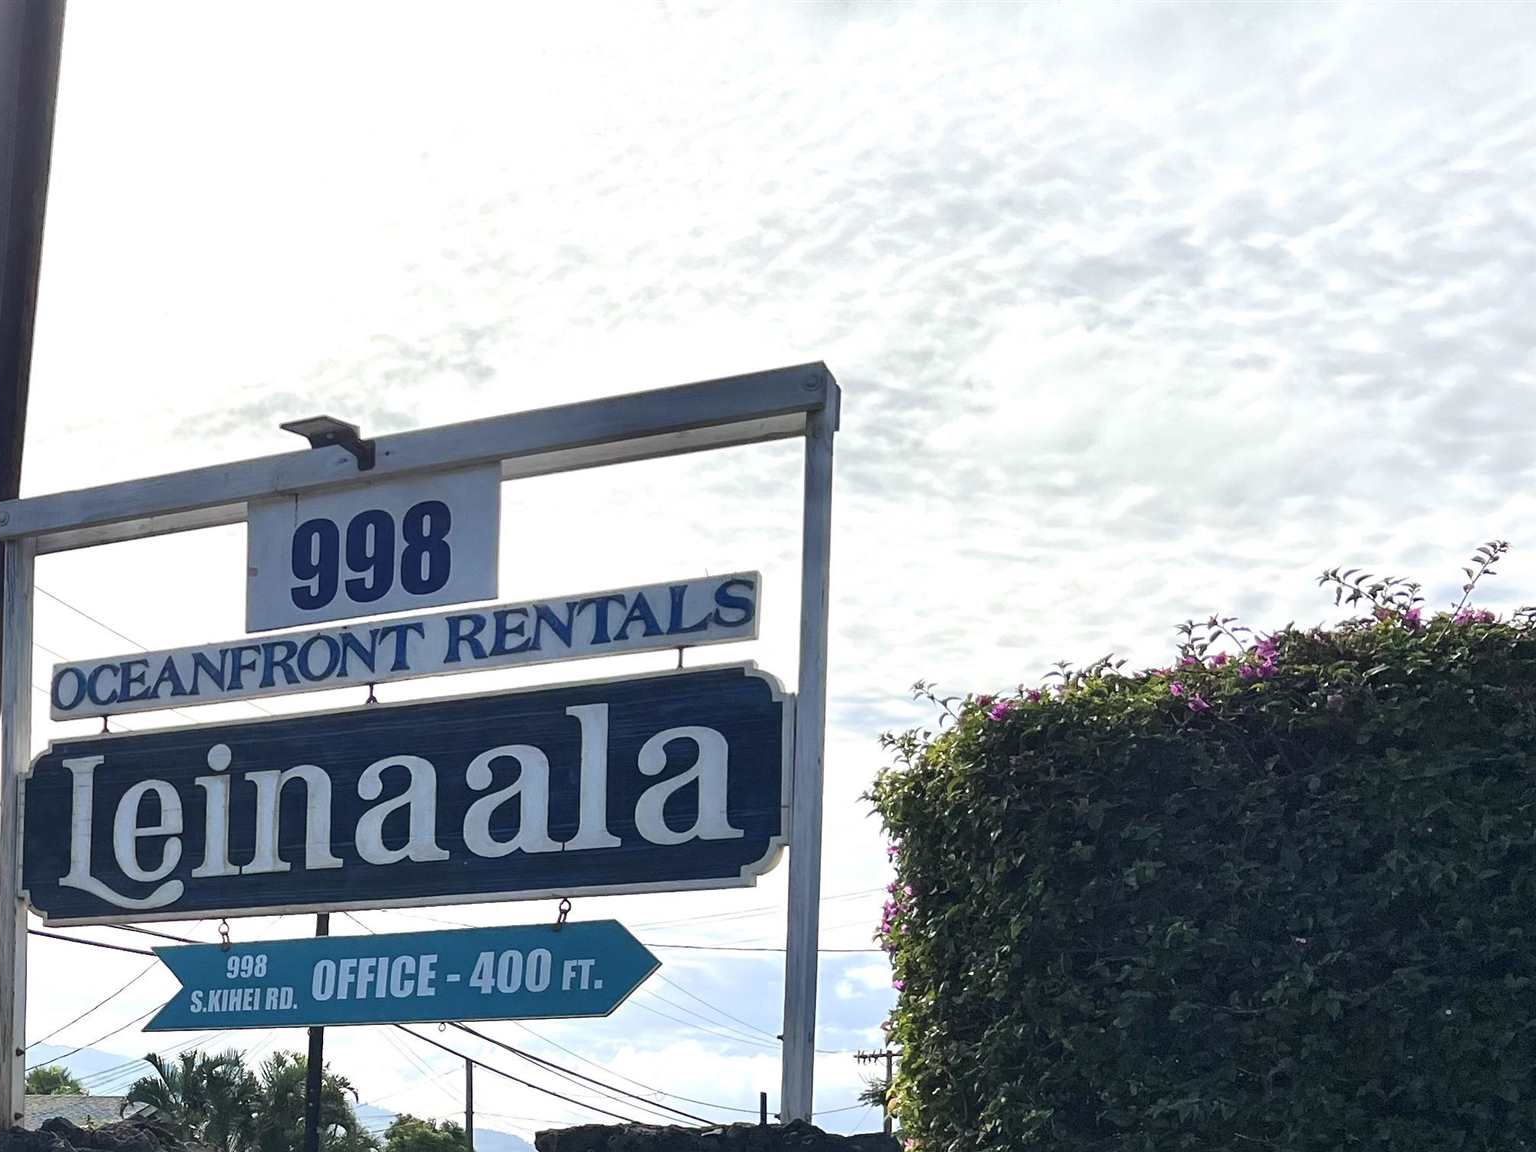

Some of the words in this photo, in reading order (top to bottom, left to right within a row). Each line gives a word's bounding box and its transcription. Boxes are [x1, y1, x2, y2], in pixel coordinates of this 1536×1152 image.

[291, 500, 451, 611] 998
[51, 622, 423, 711] OCEANFRONT
[443, 579, 756, 664] RENTALS
[58, 702, 744, 910] Leinaala
[190, 987, 261, 1014] S.KIHEI
[265, 986, 299, 1011] RD.
[225, 954, 268, 979] 998
[311, 953, 439, 1002] OFFICE
[469, 948, 552, 994] 400
[562, 958, 604, 991] FT.
